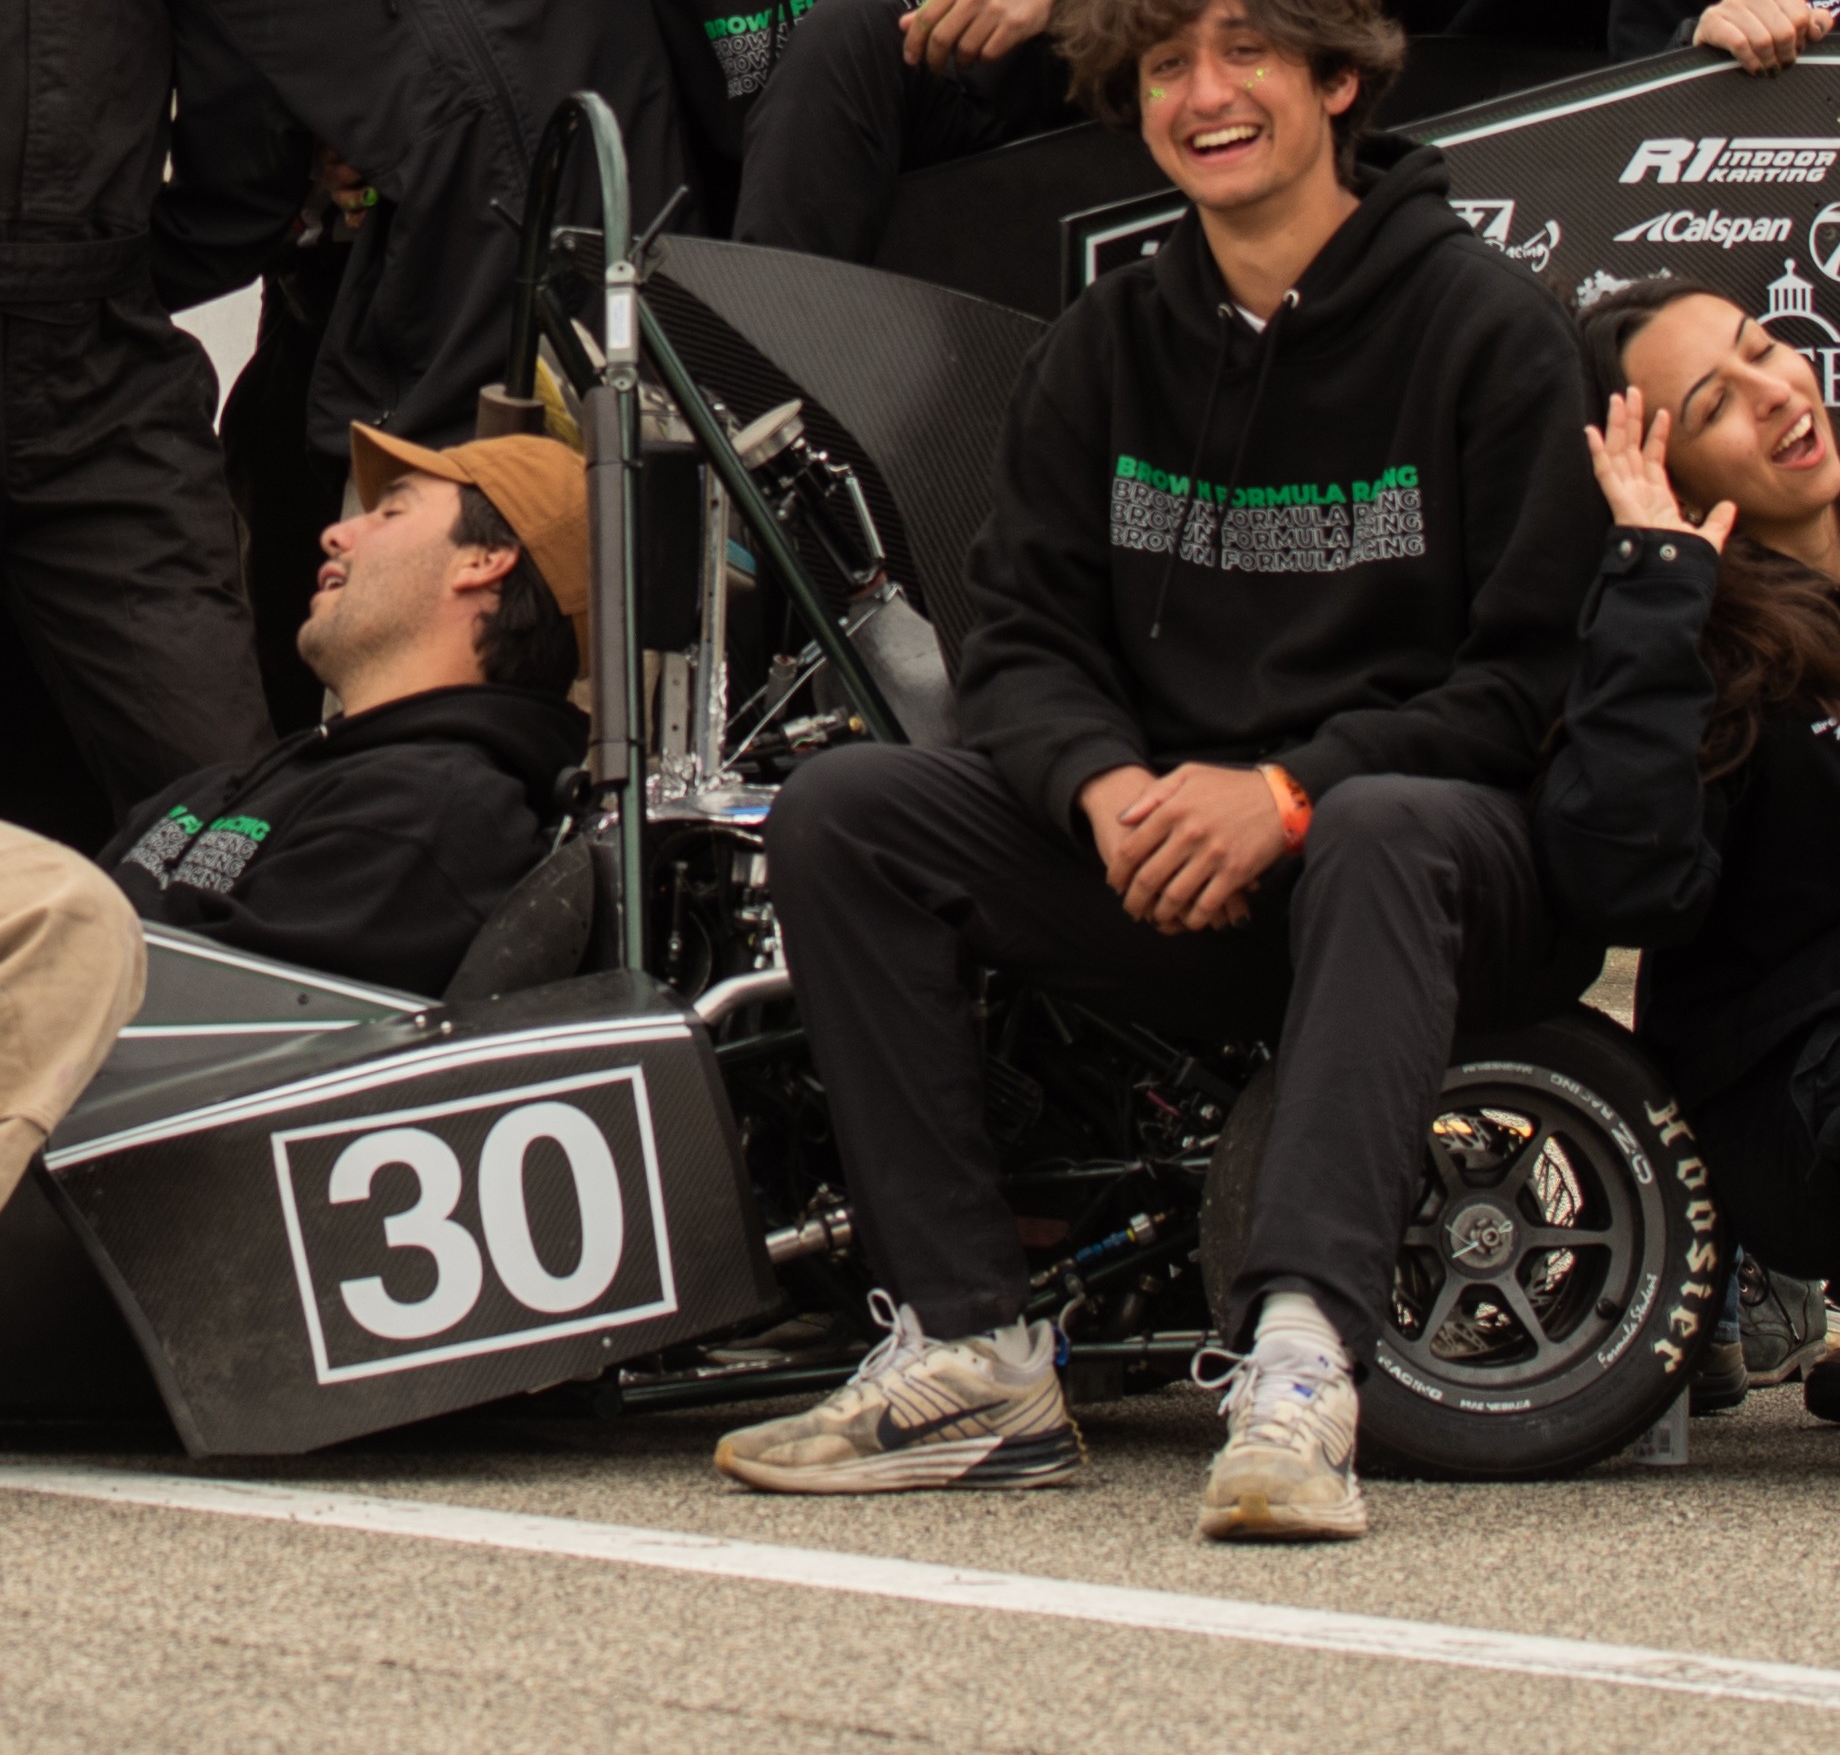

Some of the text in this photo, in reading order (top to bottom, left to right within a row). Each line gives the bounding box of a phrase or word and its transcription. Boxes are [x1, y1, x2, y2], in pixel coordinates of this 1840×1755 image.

[1620, 138, 1838, 184] R1 INDOOR
[1708, 167, 1828, 183] KARTING
[1662, 208, 1793, 249] Calspan
[327, 1099, 624, 1340] 30
[1644, 1099, 1719, 1375] Hoosier
